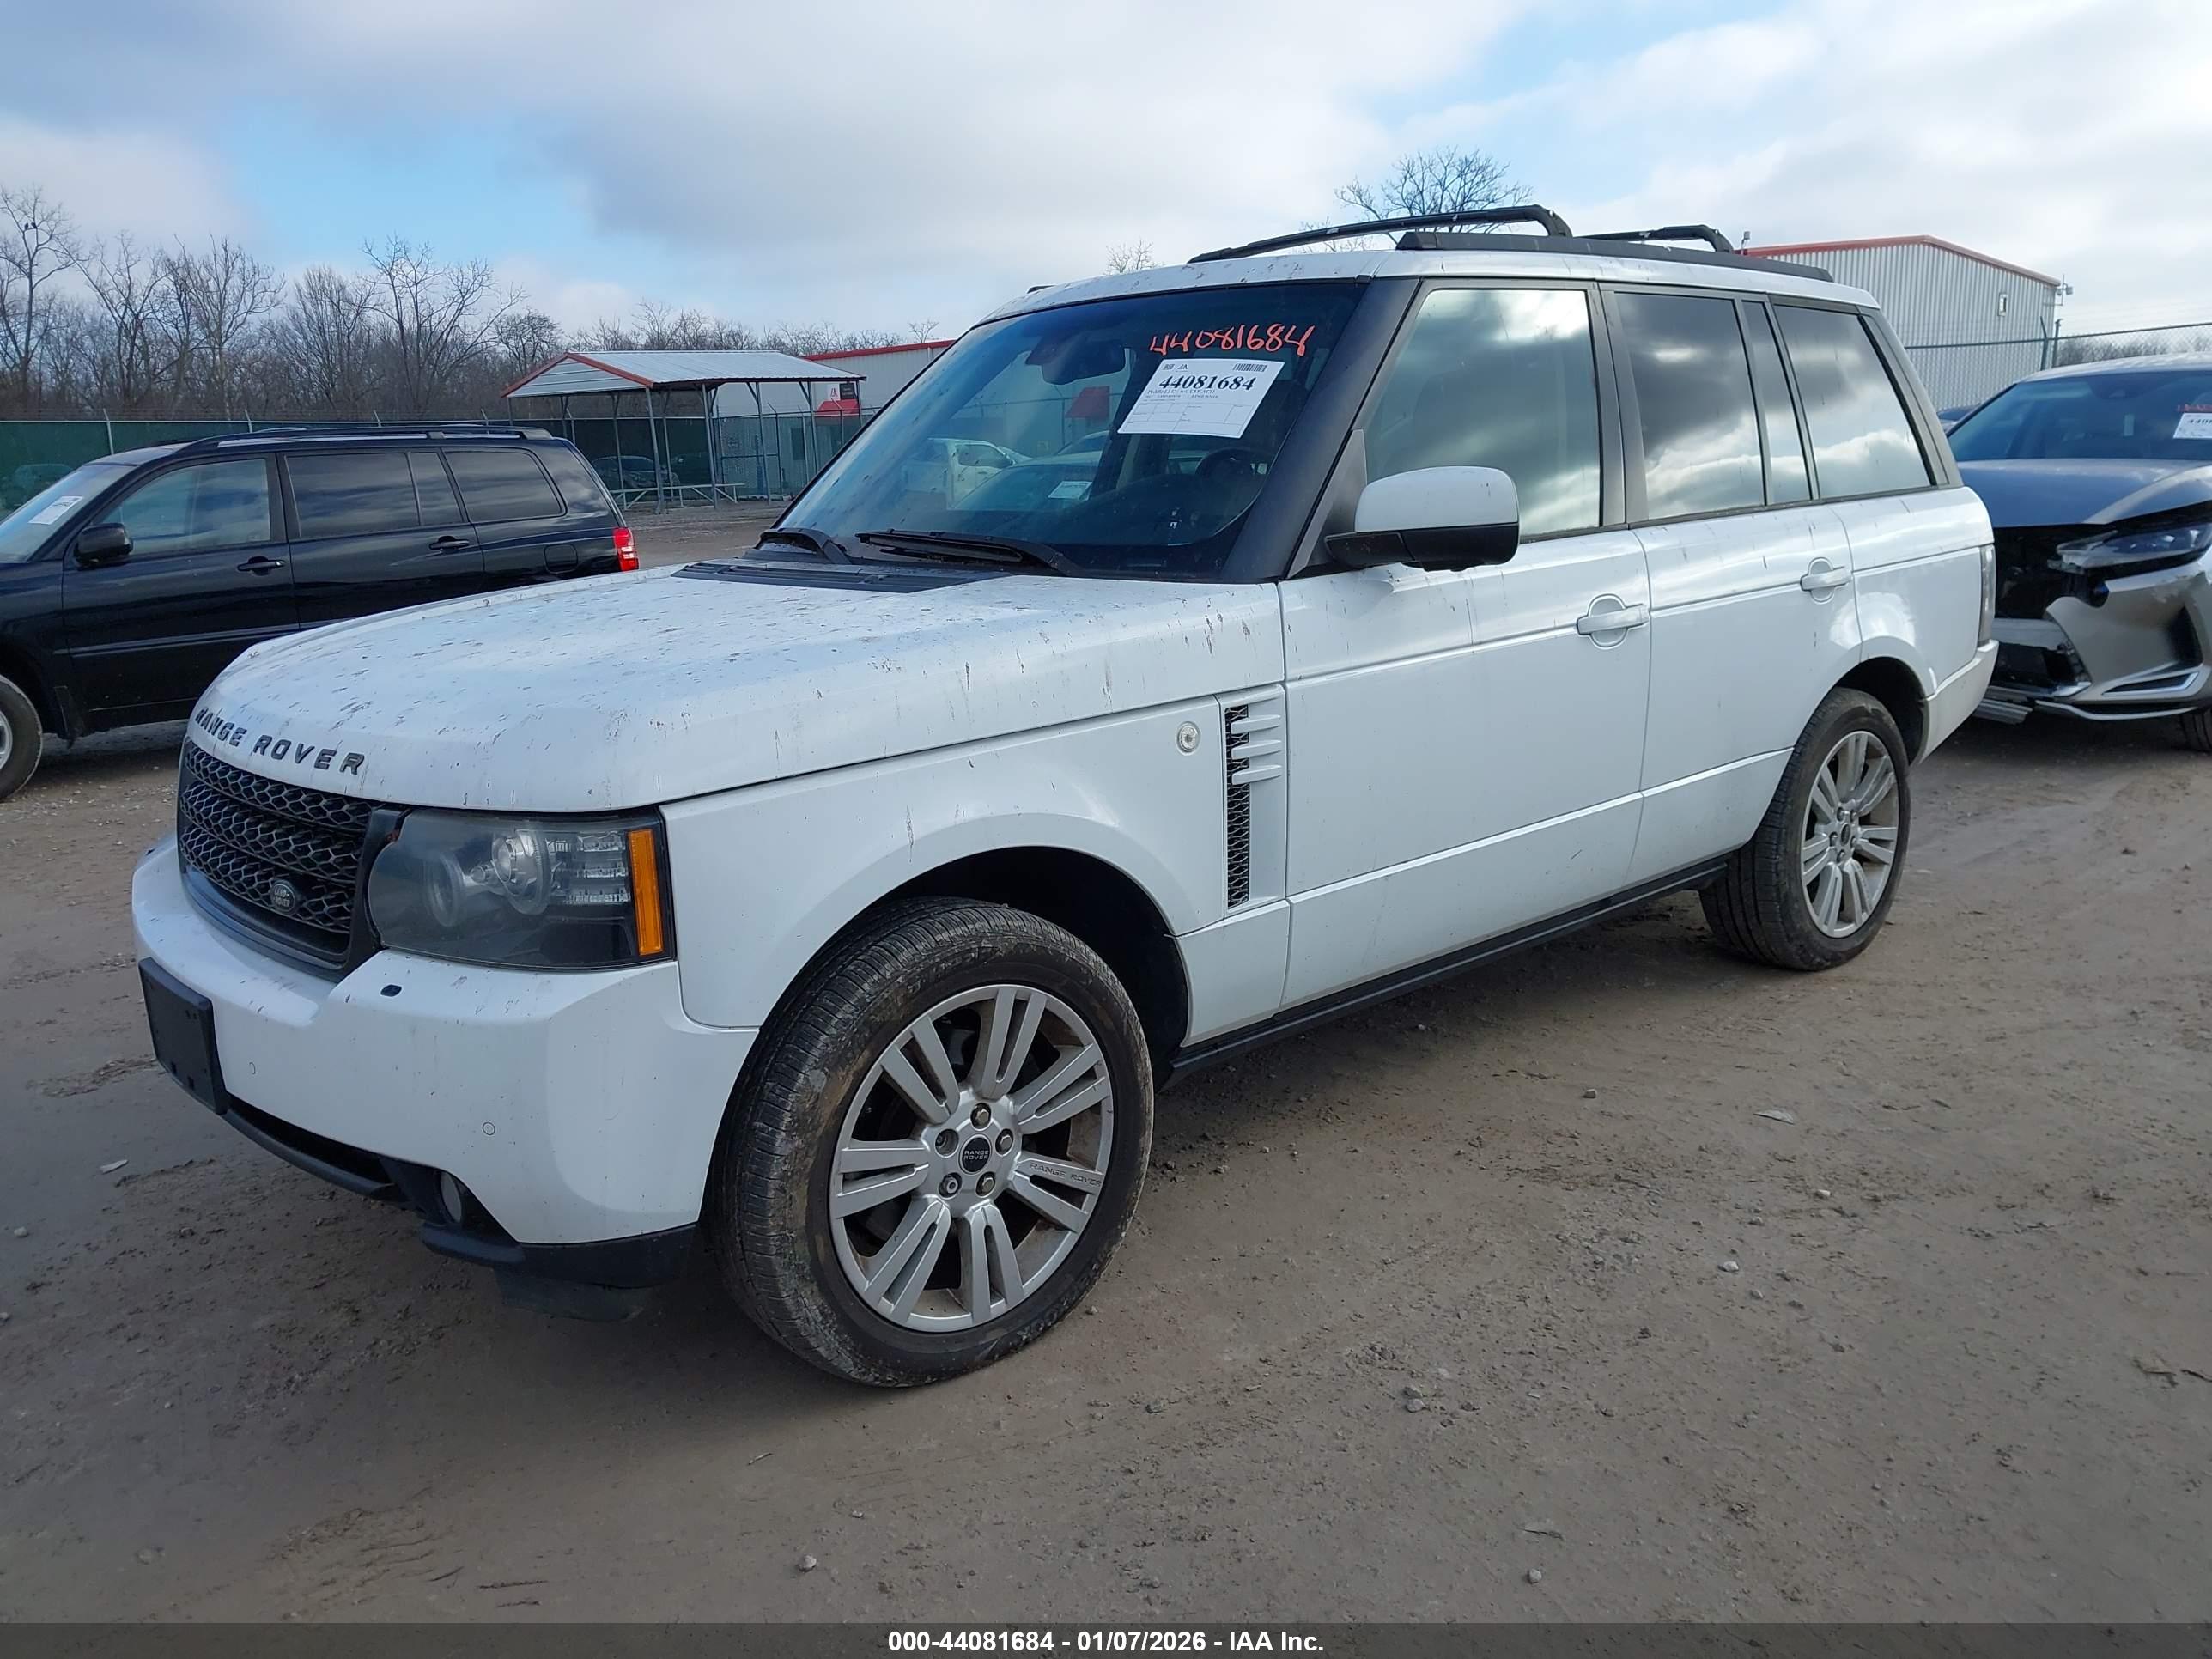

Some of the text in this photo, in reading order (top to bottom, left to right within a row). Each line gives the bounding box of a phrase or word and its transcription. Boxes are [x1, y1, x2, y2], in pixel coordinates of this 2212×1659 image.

[1150, 323, 1316, 356] 44081684
[1158, 374, 1256, 390] 44081684
[195, 708, 365, 775] RANGE ROVER
[1030, 1162, 1102, 1186] RANGE ROVER
